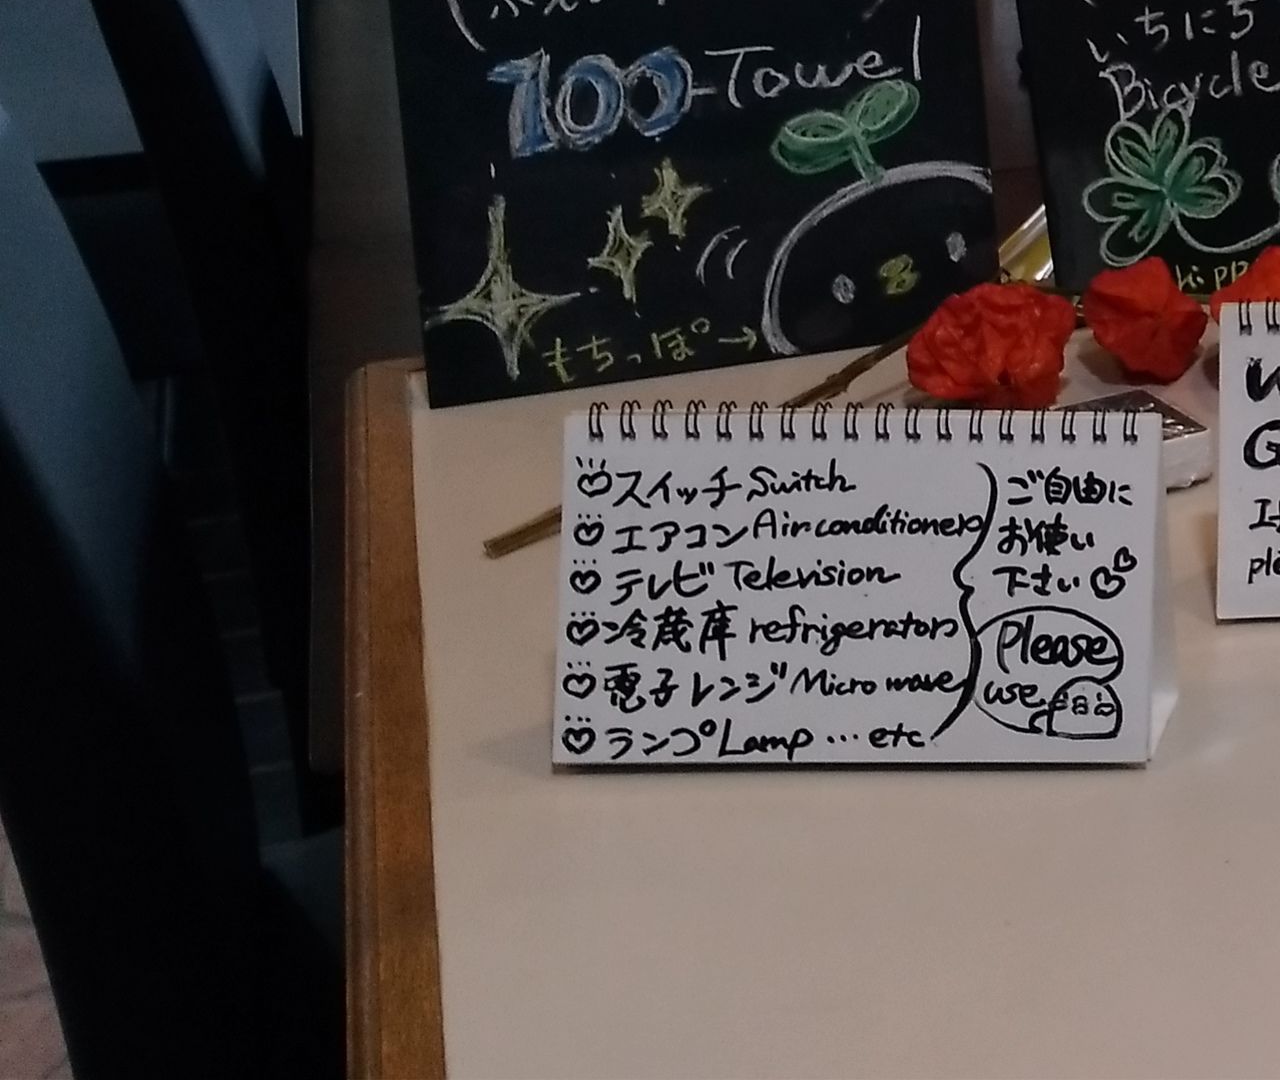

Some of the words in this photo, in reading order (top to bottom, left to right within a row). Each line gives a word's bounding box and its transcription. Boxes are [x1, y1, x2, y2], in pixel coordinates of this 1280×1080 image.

[611, 465, 743, 509] スイッチ
[746, 459, 856, 503] Switch
[1006, 466, 1134, 507] ご自由に
[611, 521, 749, 554] エアコン
[997, 513, 1096, 557] お使い
[609, 560, 714, 605] テレビ
[730, 556, 900, 592] Television
[992, 563, 1081, 597] 下さい
[602, 601, 739, 660] 冷蔵庫
[997, 615, 1117, 674] Please
[602, 662, 788, 712] 電子レンジ
[984, 681, 1045, 708] use
[606, 719, 716, 759] ランプ
[718, 720, 814, 760] Lamp
